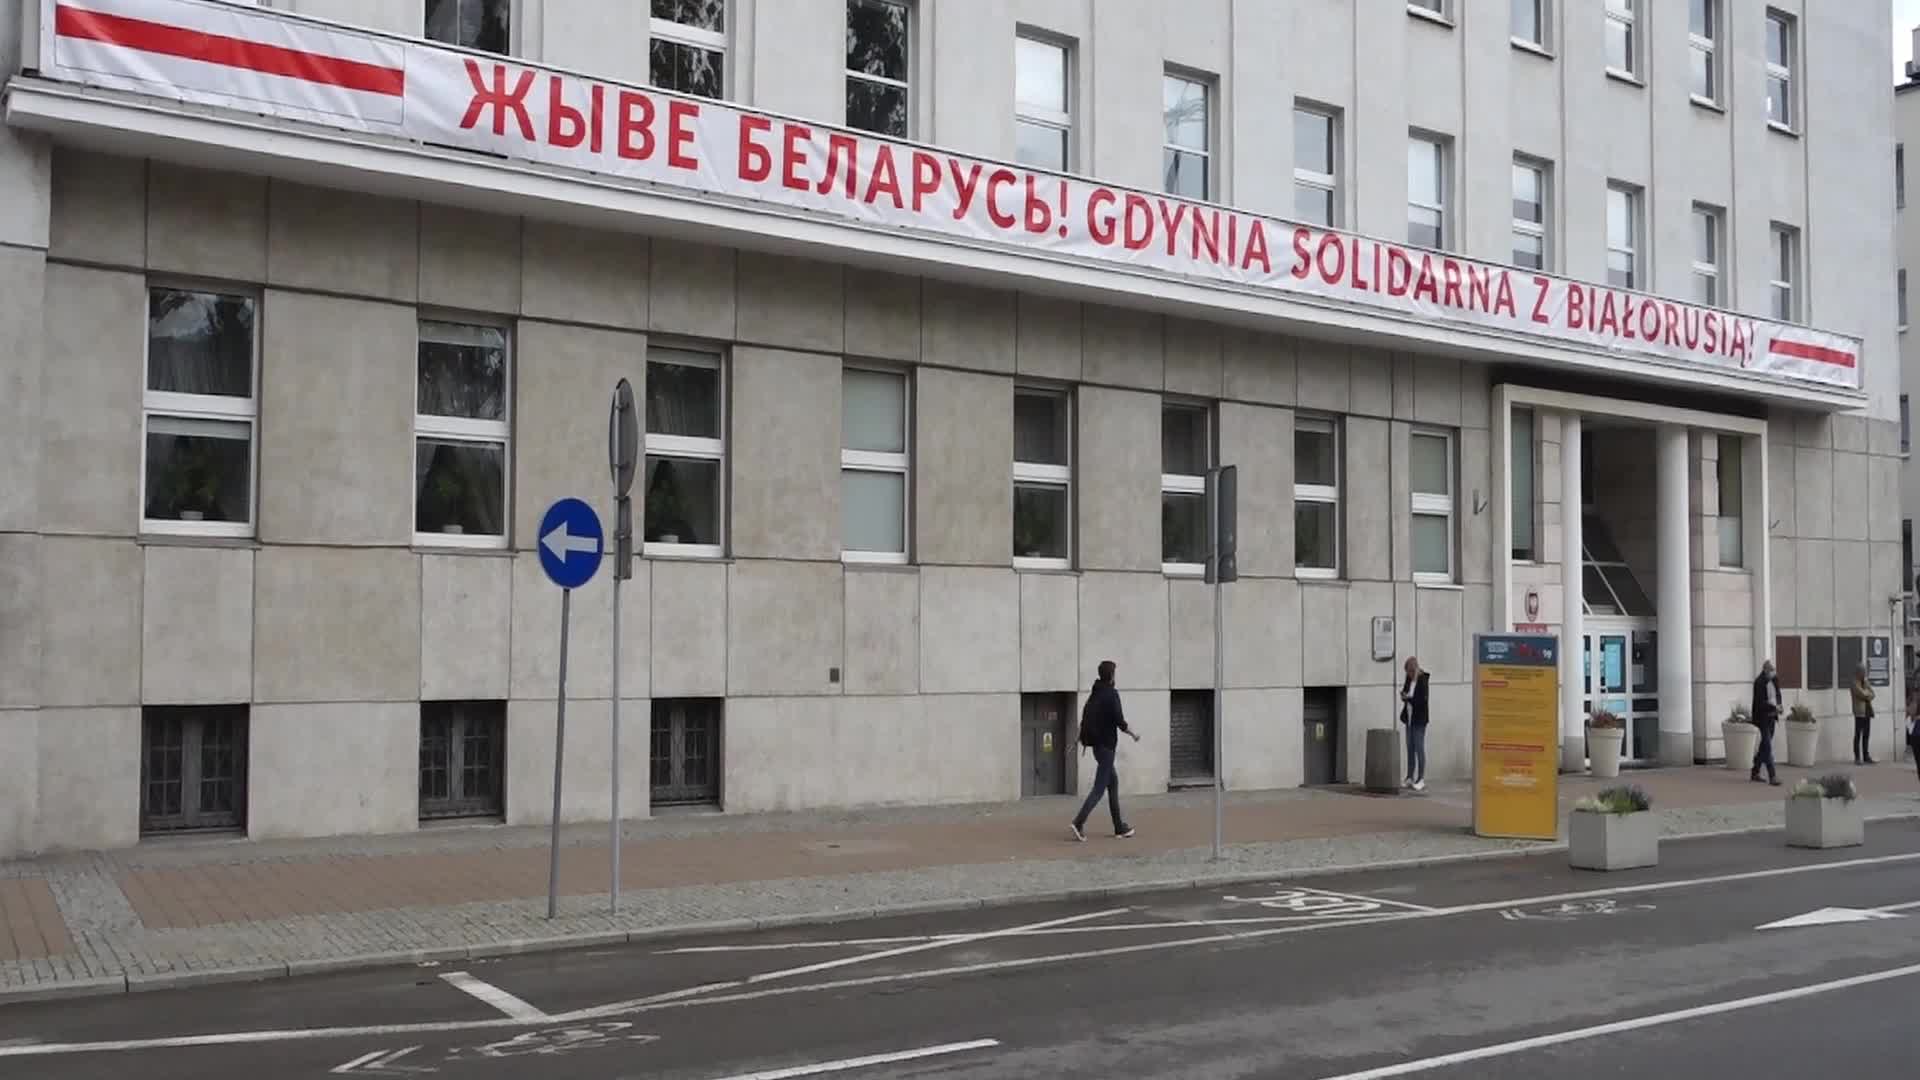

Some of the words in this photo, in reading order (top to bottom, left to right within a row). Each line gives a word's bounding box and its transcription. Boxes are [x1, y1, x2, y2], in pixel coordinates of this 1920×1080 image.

[460, 59, 699, 170] ЖЫВЕ
[738, 115, 1068, 238] БЕЛАРУСЬ!
[1087, 188, 1271, 274] GDYNIA
[1291, 228, 1516, 319] SOLIDARNA
[1532, 277, 1551, 324] Z
[1567, 284, 1755, 367] BIAŁORUSIĄ!
